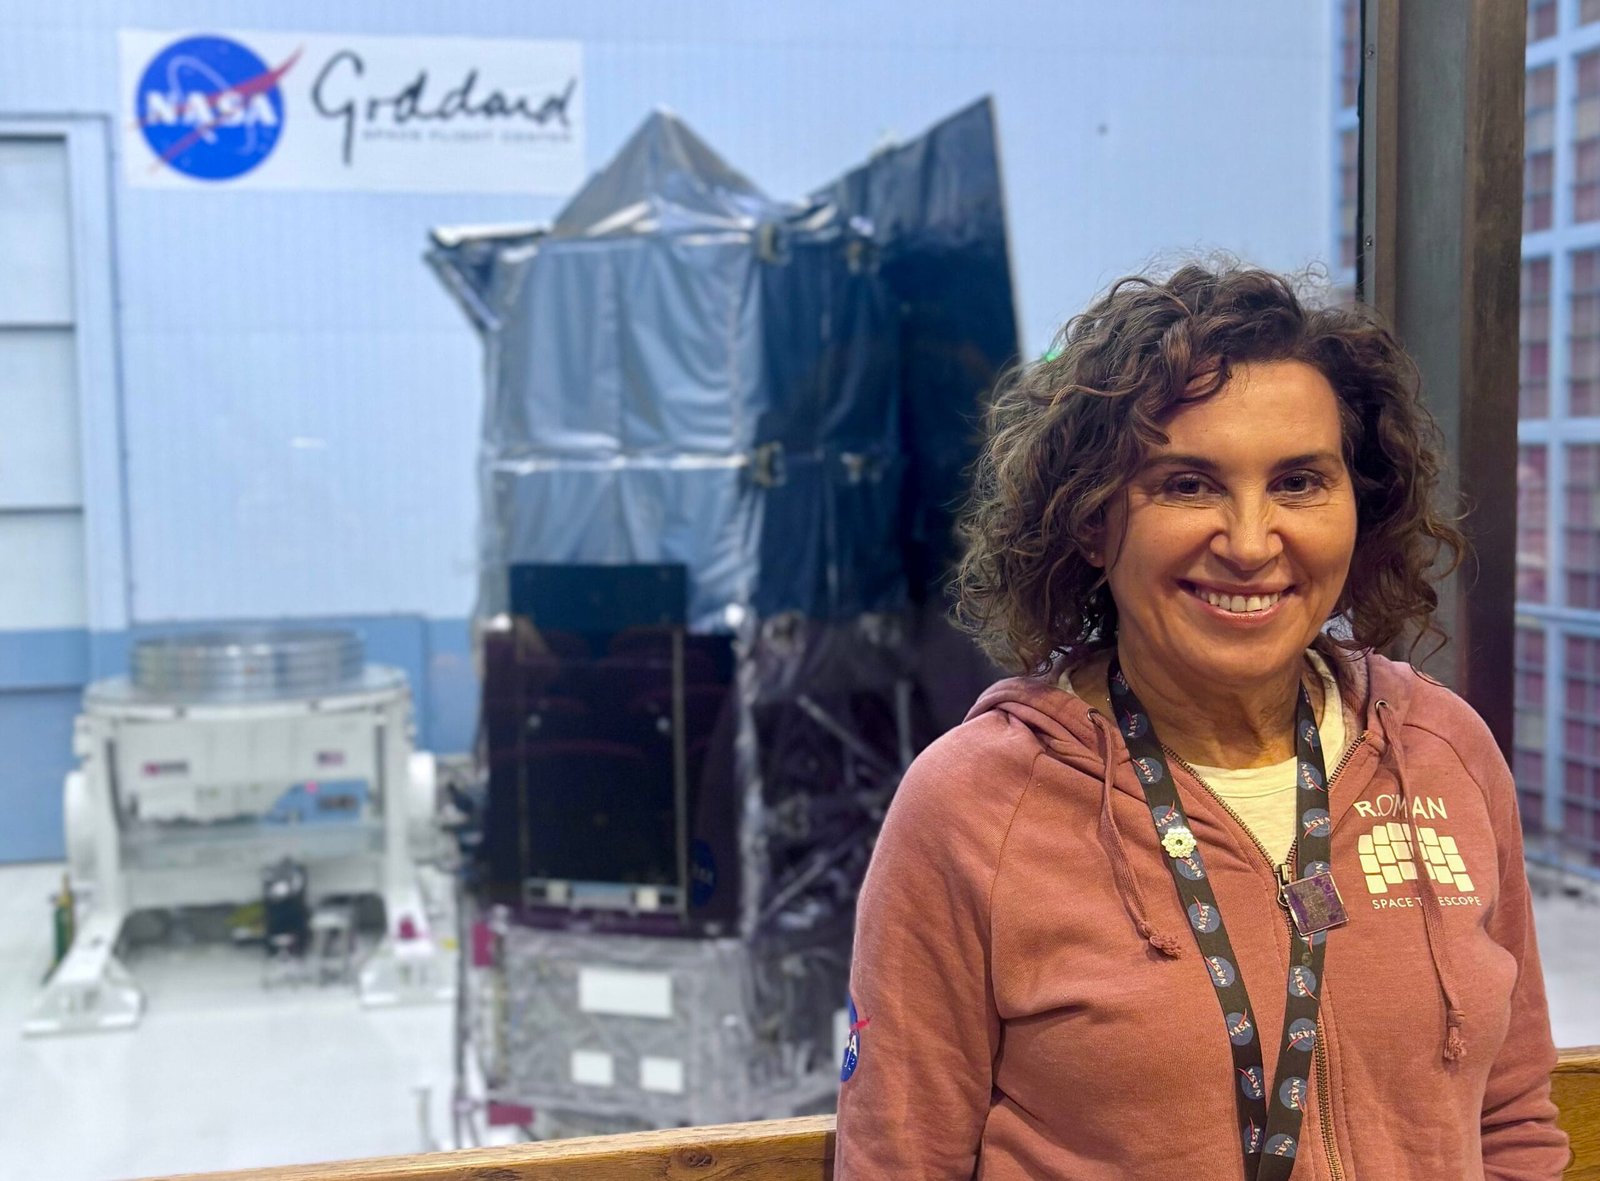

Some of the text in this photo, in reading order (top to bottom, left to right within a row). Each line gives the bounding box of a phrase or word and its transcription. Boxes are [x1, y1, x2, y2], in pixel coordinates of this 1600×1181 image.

[147, 91, 279, 126] NASA
[311, 50, 577, 166] Goddard
[1353, 794, 1448, 819] ROMAN
[1187, 858, 1204, 878] NAS
[1372, 896, 1482, 909] SPACE TESCOPE
[1198, 905, 1210, 931] NASA
[1211, 957, 1228, 985] NASA
[1293, 967, 1307, 996] NASA
[1247, 1067, 1262, 1097] NASA
[1290, 1078, 1301, 1109] NASA
